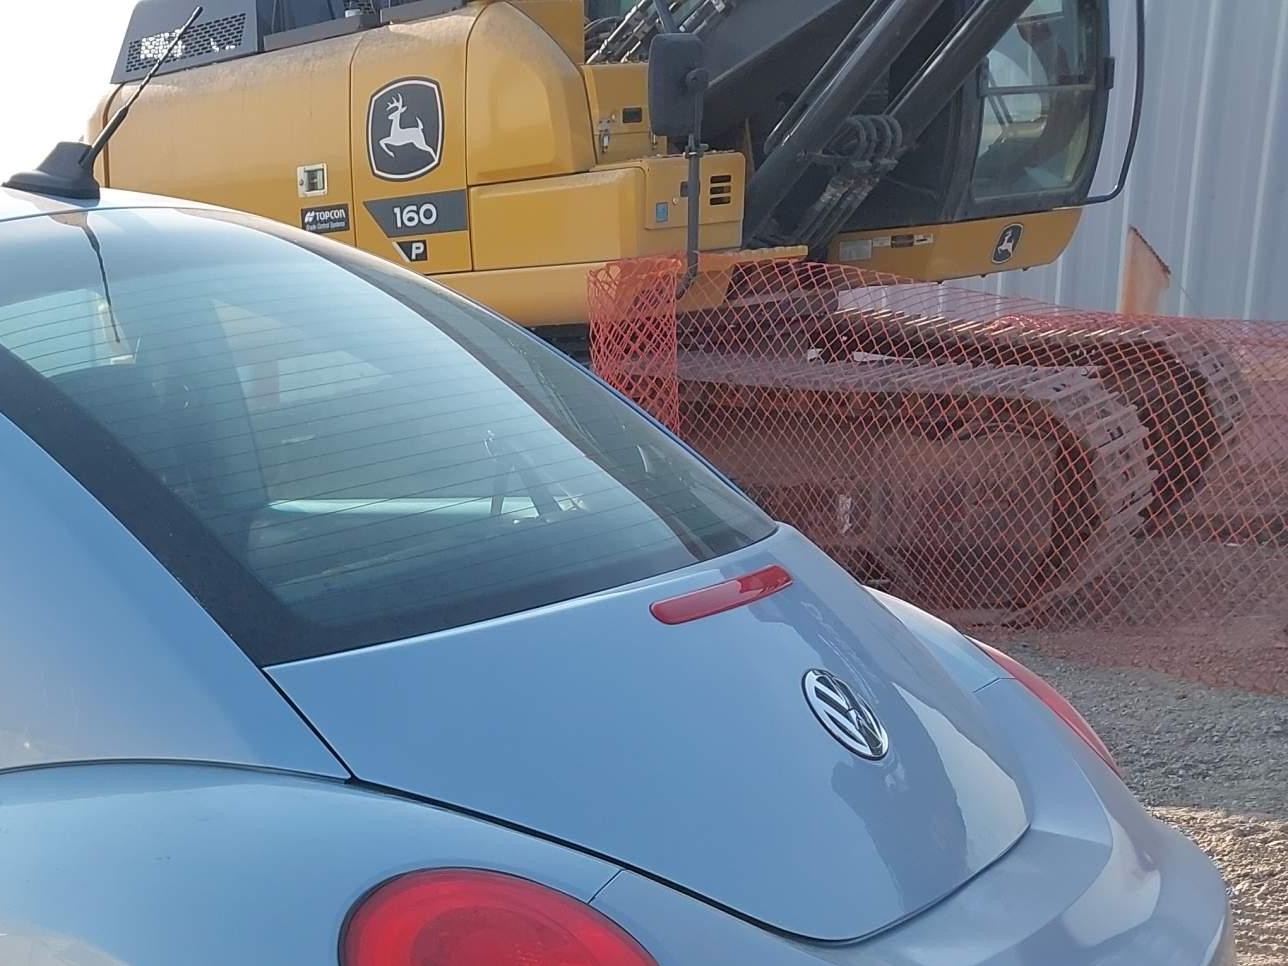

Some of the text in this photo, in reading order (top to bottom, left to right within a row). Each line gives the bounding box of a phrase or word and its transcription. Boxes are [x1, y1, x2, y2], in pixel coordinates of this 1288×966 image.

[315, 209, 346, 221] TOPCON
[393, 203, 437, 228] 160
[411, 242, 424, 260] P
